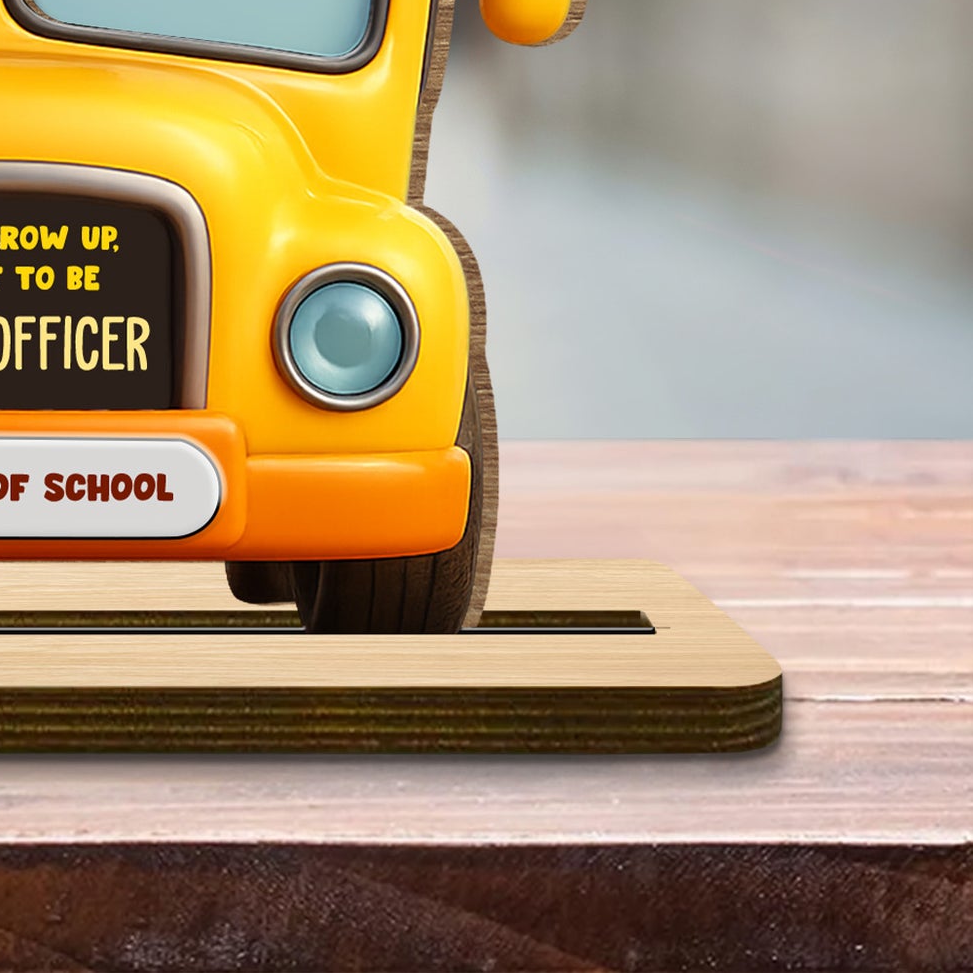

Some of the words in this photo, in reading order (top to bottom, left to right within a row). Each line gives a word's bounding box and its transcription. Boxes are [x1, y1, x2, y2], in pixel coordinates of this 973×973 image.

[81, 225, 120, 253] UP,
[14, 265, 55, 291] TO
[66, 265, 100, 291] BE
[43, 472, 174, 502] SCHOOL
